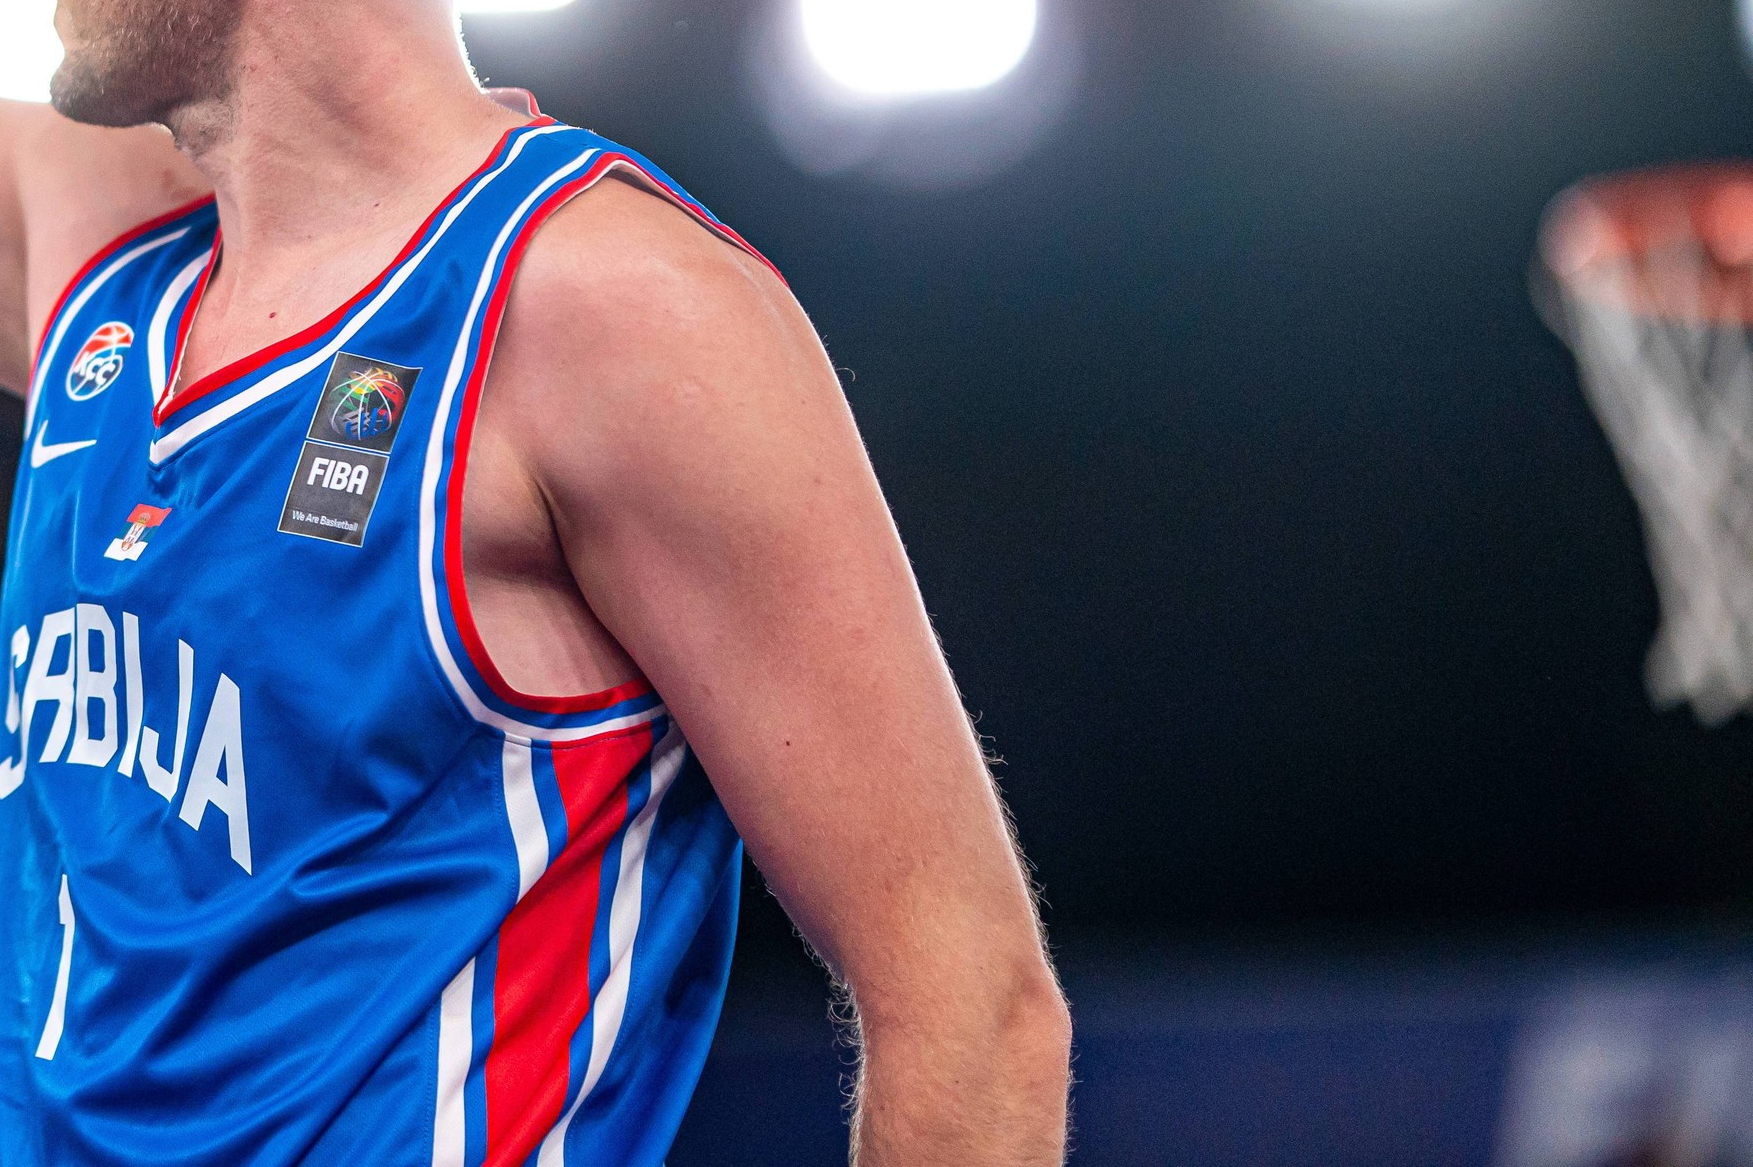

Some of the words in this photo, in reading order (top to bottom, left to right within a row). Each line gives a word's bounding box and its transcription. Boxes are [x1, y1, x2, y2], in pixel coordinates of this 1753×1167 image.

[306, 456, 370, 495] FIBA
[292, 510, 306, 522] We
[305, 513, 320, 525] Are
[319, 515, 359, 532] Basketball
